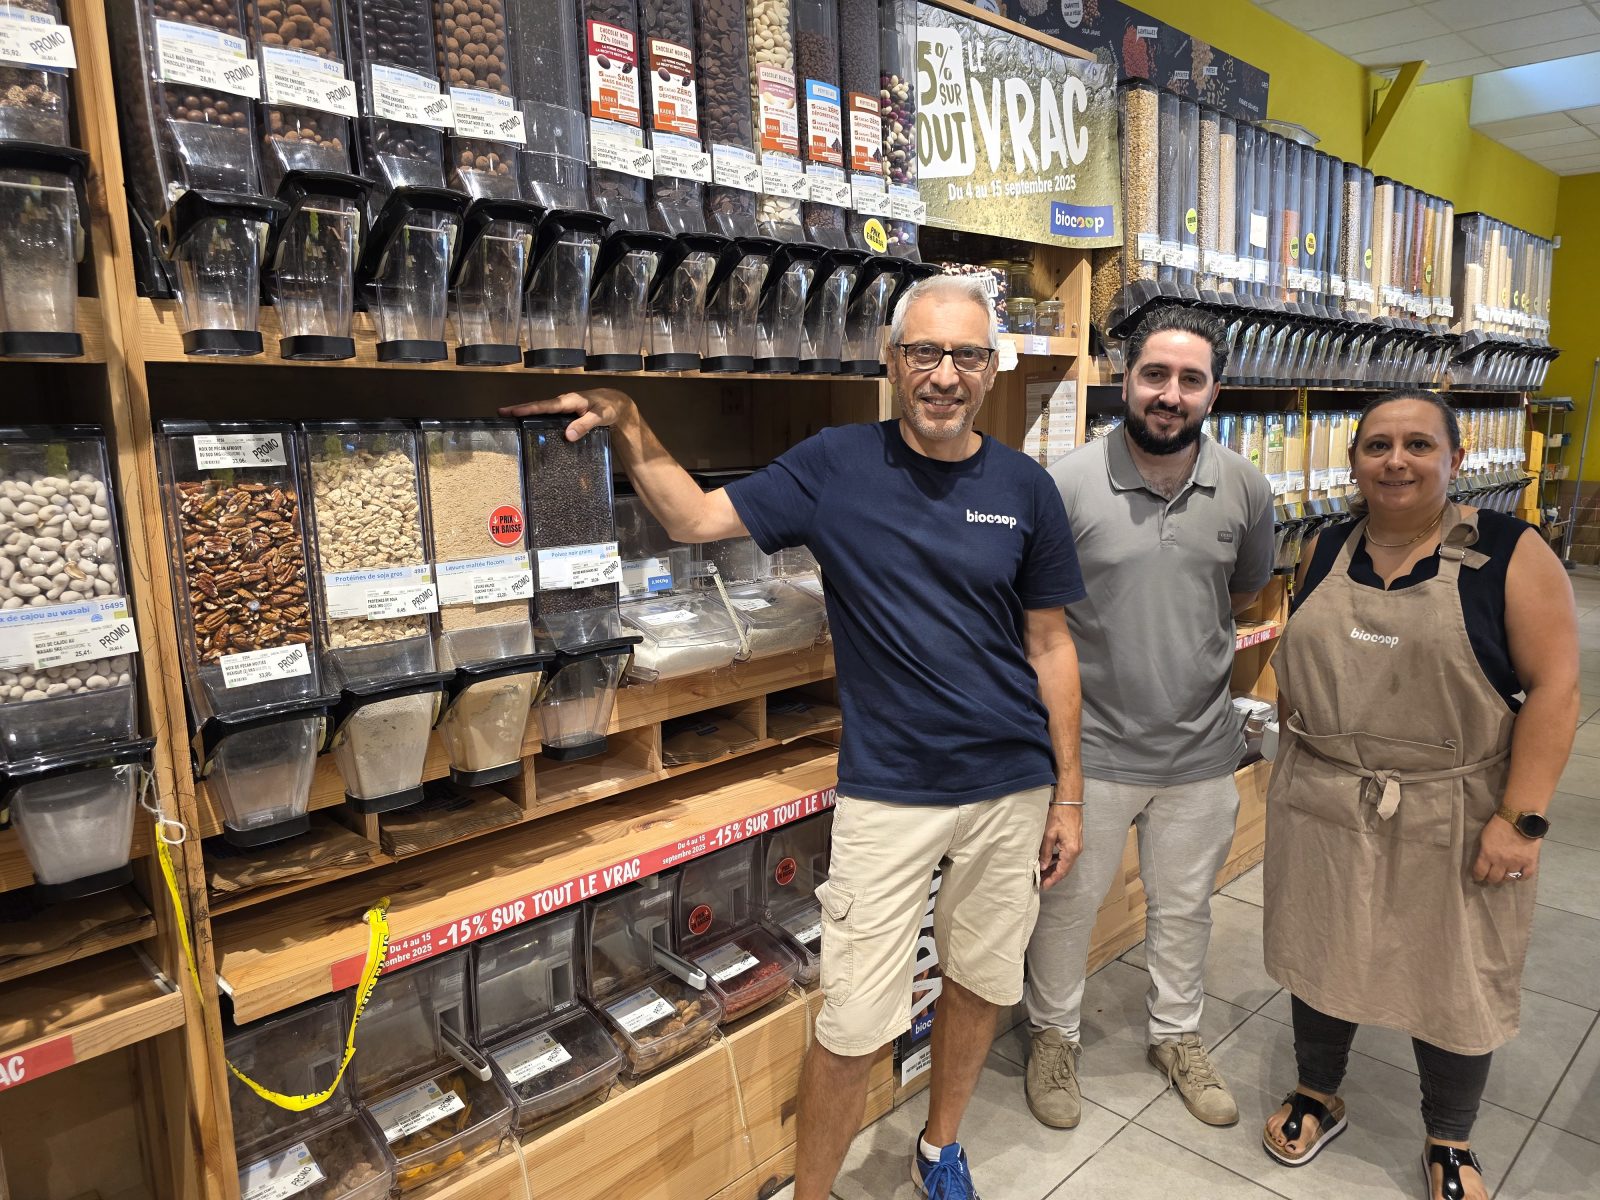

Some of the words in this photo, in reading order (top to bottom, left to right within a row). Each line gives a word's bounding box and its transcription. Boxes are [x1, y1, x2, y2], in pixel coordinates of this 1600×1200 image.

[1136, 26, 1156, 36] LENTILLES
[29, 32, 65, 55] PROMO
[967, 41, 986, 73] LE
[224, 64, 254, 84] PROMO
[617, 74, 634, 84] SANS
[326, 85, 351, 104] PROMO
[676, 86, 692, 98] ZÉRO
[940, 82, 963, 108] SUR
[424, 98, 448, 118] PROMO
[500, 116, 520, 134] PROMO
[918, 112, 967, 168] OUT
[970, 76, 1089, 174] VRAC
[632, 154, 652, 170] PROMO
[691, 158, 709, 174] PROMO
[743, 169, 760, 184] PROMO
[791, 177, 807, 193] PROMO
[835, 186, 849, 200] PROMO
[948, 184, 964, 201] Du
[965, 184, 973, 198] 4
[975, 188, 988, 199] au
[992, 182, 1002, 196] 15
[1004, 178, 1053, 199] septembre
[1054, 174, 1076, 192] 2025
[1055, 208, 1104, 234] biocoop
[252, 438, 279, 460] PROMO
[500, 516, 514, 524] PRIX
[966, 508, 1018, 530] biocoop
[492, 525, 500, 534] EN
[501, 524, 522, 534] BAISSE
[335, 574, 366, 582] Protéines
[368, 572, 376, 580] de
[377, 572, 390, 580] soja
[390, 572, 403, 580] gros
[445, 564, 466, 572] Levure
[602, 560, 618, 578] PROMO
[512, 574, 530, 595] PROMO
[100, 602, 124, 611] 16495
[412, 588, 434, 609] PROMO
[7, 614, 19, 622] de
[20, 610, 45, 624] cajou
[47, 610, 58, 618] au
[60, 607, 90, 618] wasabi
[99, 624, 130, 648] PROMO
[1350, 627, 1399, 649] biocoop
[278, 649, 302, 672] PROMO
[662, 848, 692, 865] septembre
[692, 844, 706, 856] 2025
[709, 821, 742, 847] -15%
[745, 814, 768, 837] SUR
[773, 800, 802, 826] TOUT
[805, 794, 818, 815] LE
[821, 788, 836, 808] VR
[677, 842, 686, 850] Du
[686, 840, 691, 848] 4
[698, 834, 706, 842] 15
[438, 913, 488, 946] -15%
[492, 900, 526, 932] SUR
[532, 881, 574, 916] TOUT
[580, 874, 598, 900] LE
[603, 858, 640, 889] VRAC
[390, 945, 401, 954] Du
[402, 941, 409, 950] 4
[421, 932, 432, 942] 15
[383, 952, 410, 968] embre
[412, 944, 432, 958] 2025
[547, 1046, 562, 1063] PROMO
[438, 1094, 456, 1112] PROMO
[291, 1166, 312, 1187] PROMO
